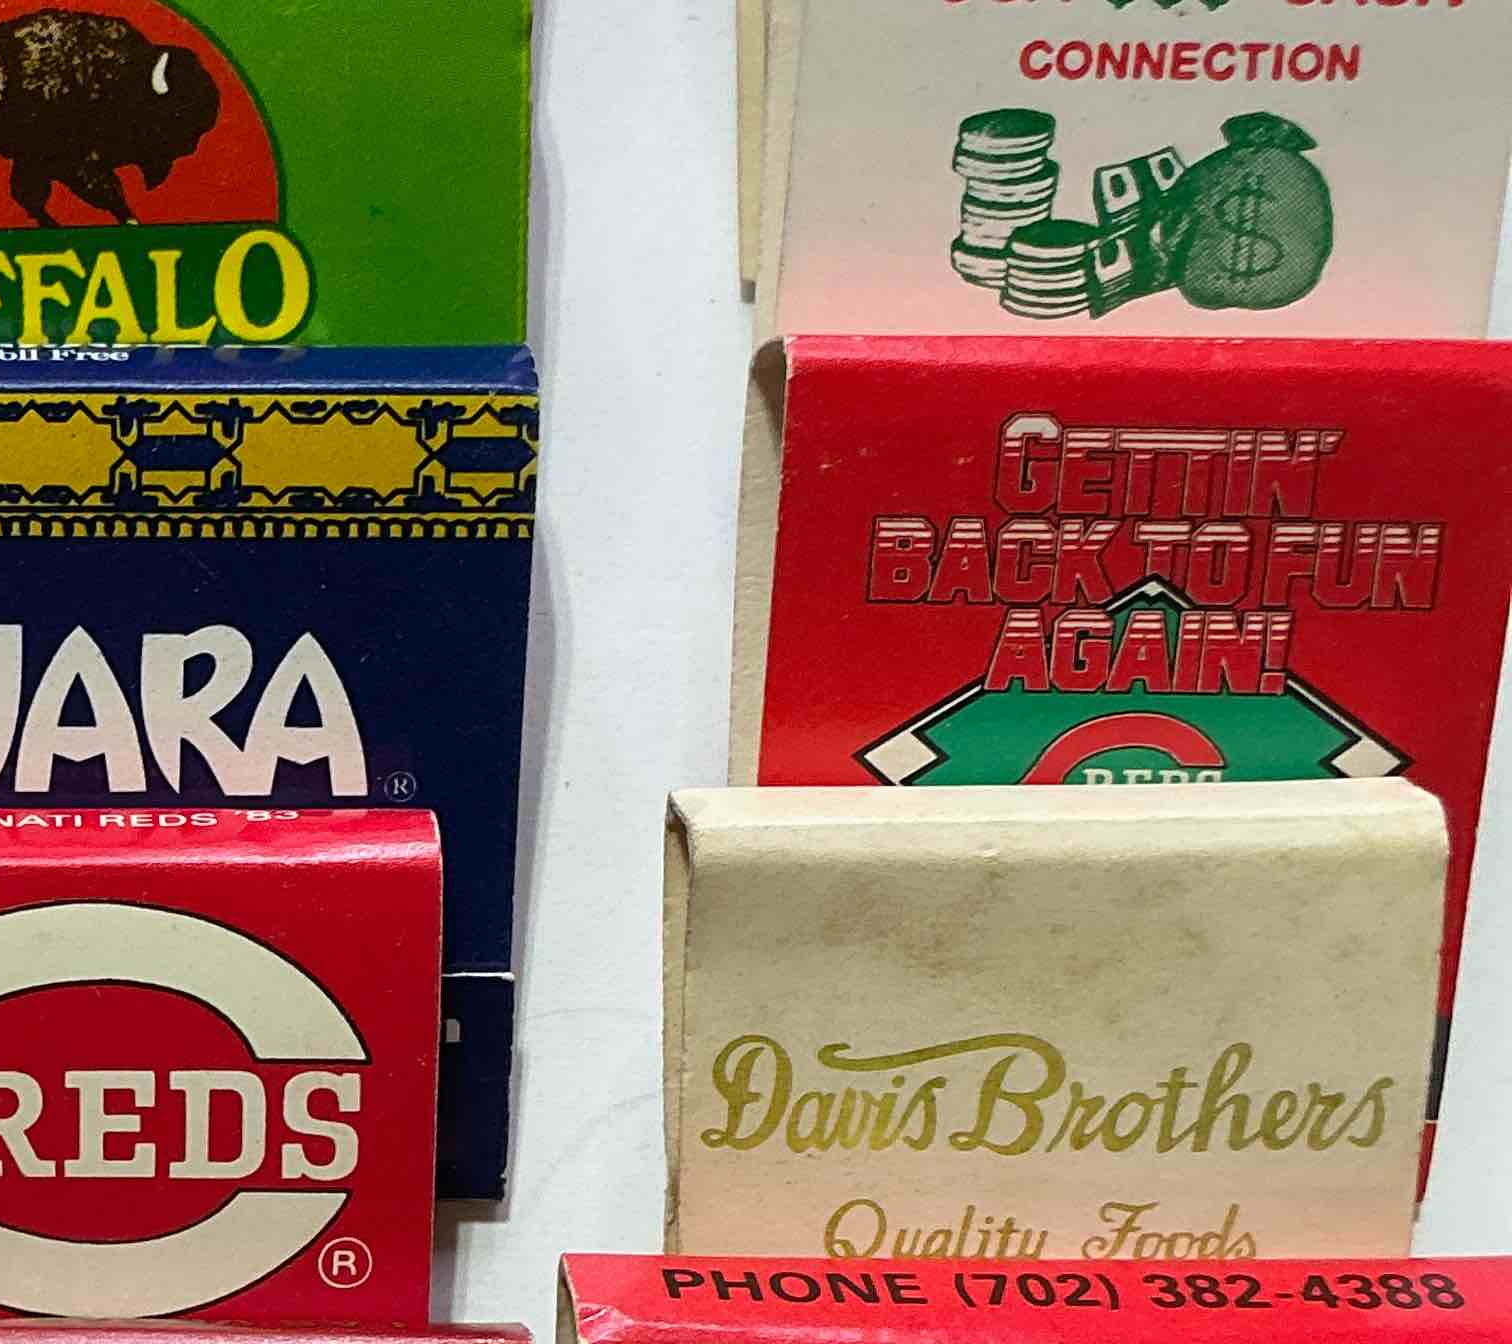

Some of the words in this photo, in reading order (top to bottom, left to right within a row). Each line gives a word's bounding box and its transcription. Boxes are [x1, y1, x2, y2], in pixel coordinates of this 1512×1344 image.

[1018, 39, 1361, 83] CONNECTION
[48, 347, 131, 363] Free
[865, 515, 1116, 607] BACK
[1131, 519, 1253, 607] TO
[1260, 520, 1448, 611] FUN
[984, 607, 1296, 697] AGAIN!
[99, 810, 219, 828] REDS
[700, 1033, 946, 1155] Davis
[817, 1031, 1397, 1157] Brothers
[823, 1197, 1050, 1261] Quality
[1081, 1199, 1258, 1261] Foods
[660, 1267, 929, 1306] PHONE
[953, 1271, 1121, 1312] (702)
[1149, 1270, 1468, 1312] 382-4388
